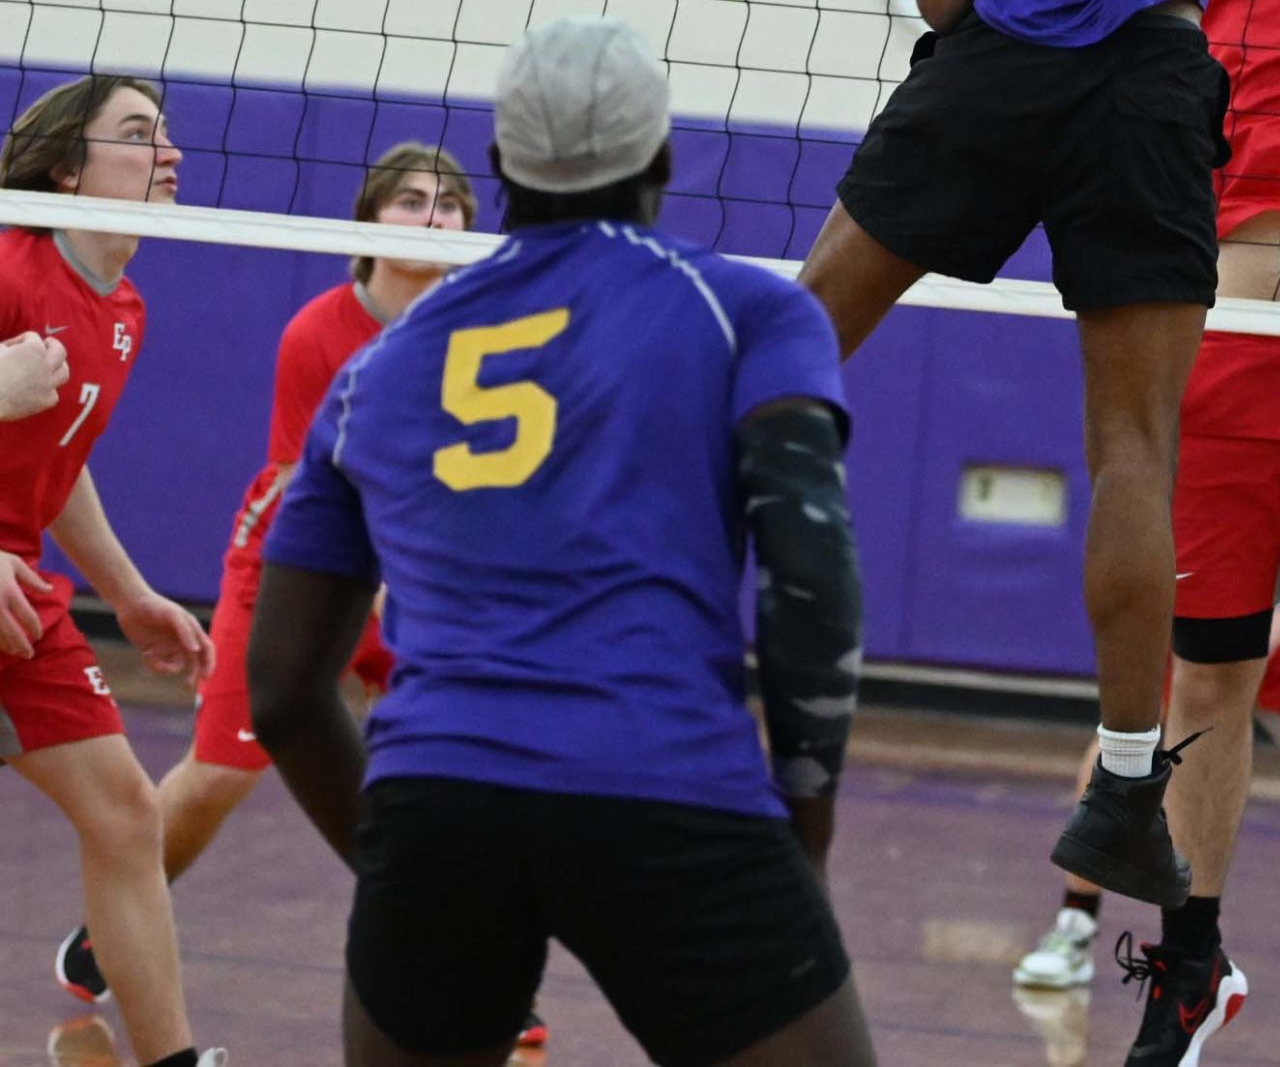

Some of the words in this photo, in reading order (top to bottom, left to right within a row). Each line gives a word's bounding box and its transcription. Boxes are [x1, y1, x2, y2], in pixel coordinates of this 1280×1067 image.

[113, 322, 133, 361] EP
[58, 382, 100, 446] 7
[433, 306, 570, 491] 5
